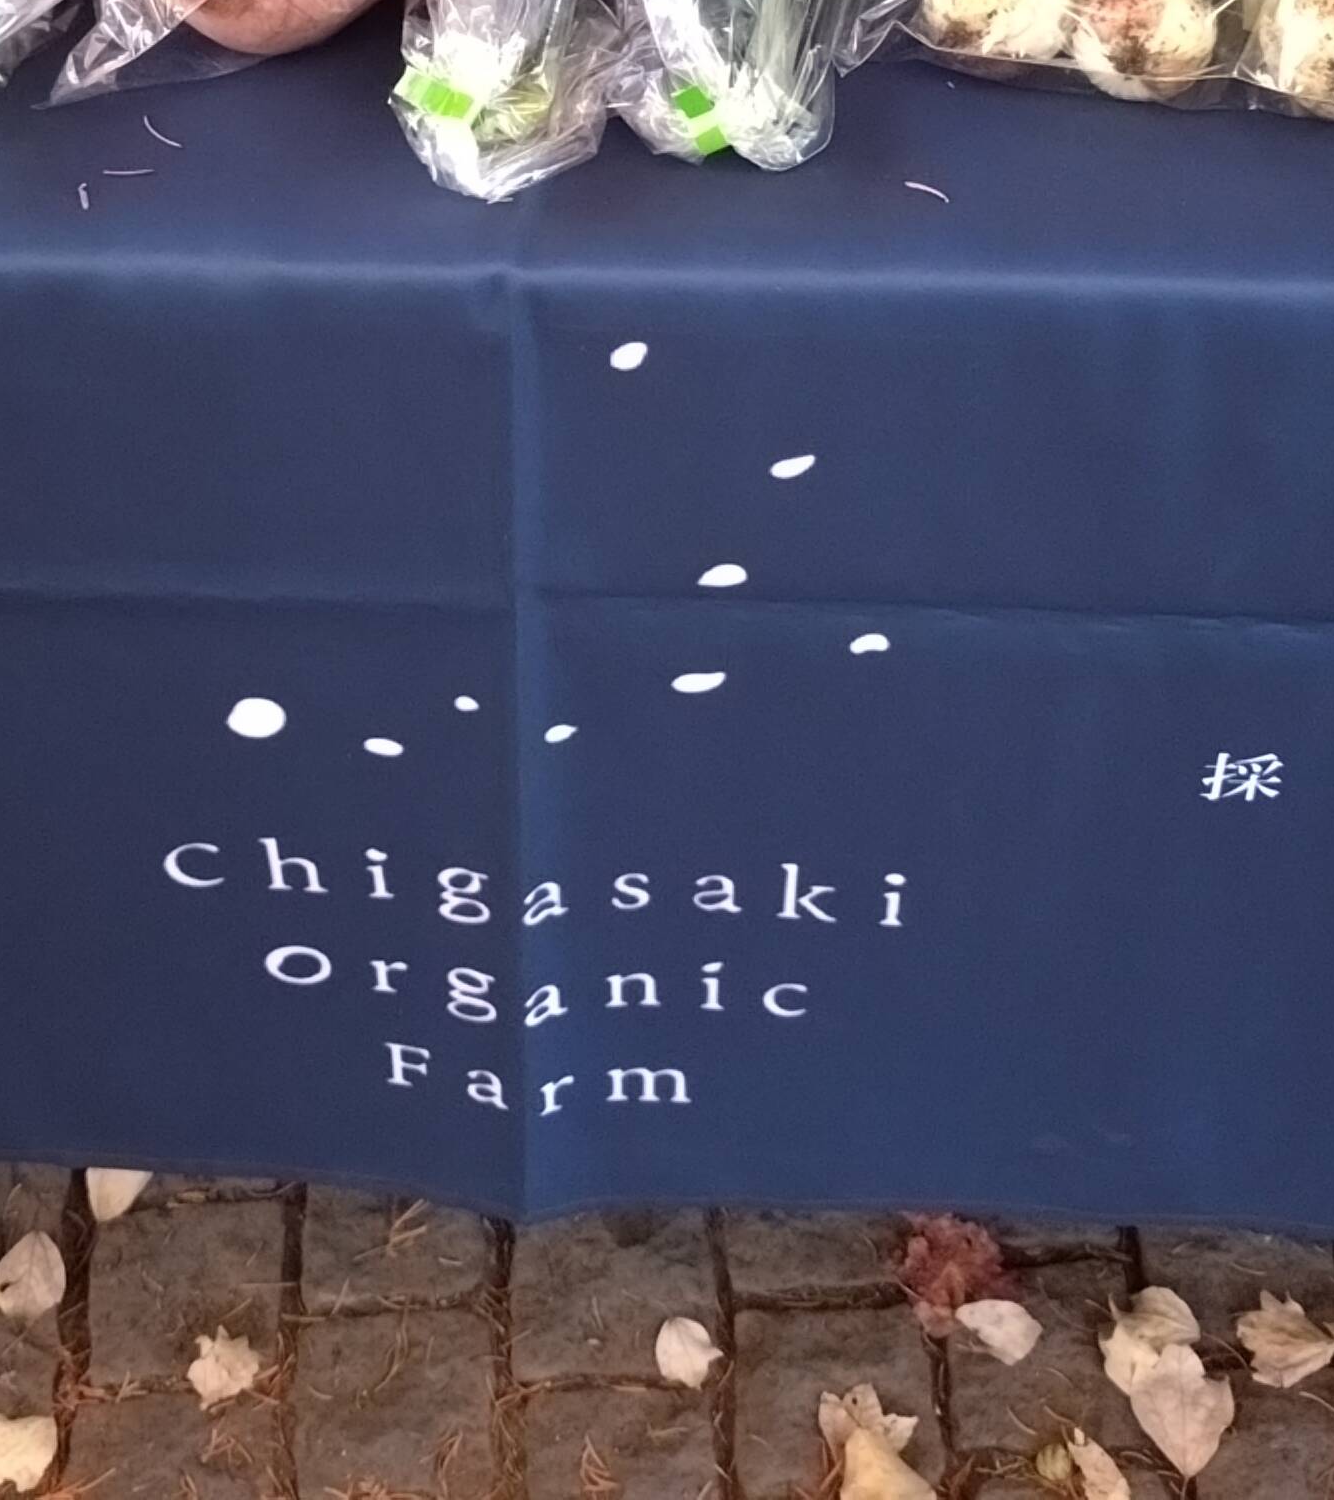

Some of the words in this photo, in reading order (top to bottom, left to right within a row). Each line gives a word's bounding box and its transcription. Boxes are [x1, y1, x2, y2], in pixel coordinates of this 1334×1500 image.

[162, 836, 908, 927] Chigasaki
[264, 944, 810, 1027] Organic
[384, 1041, 692, 1116] Farm
